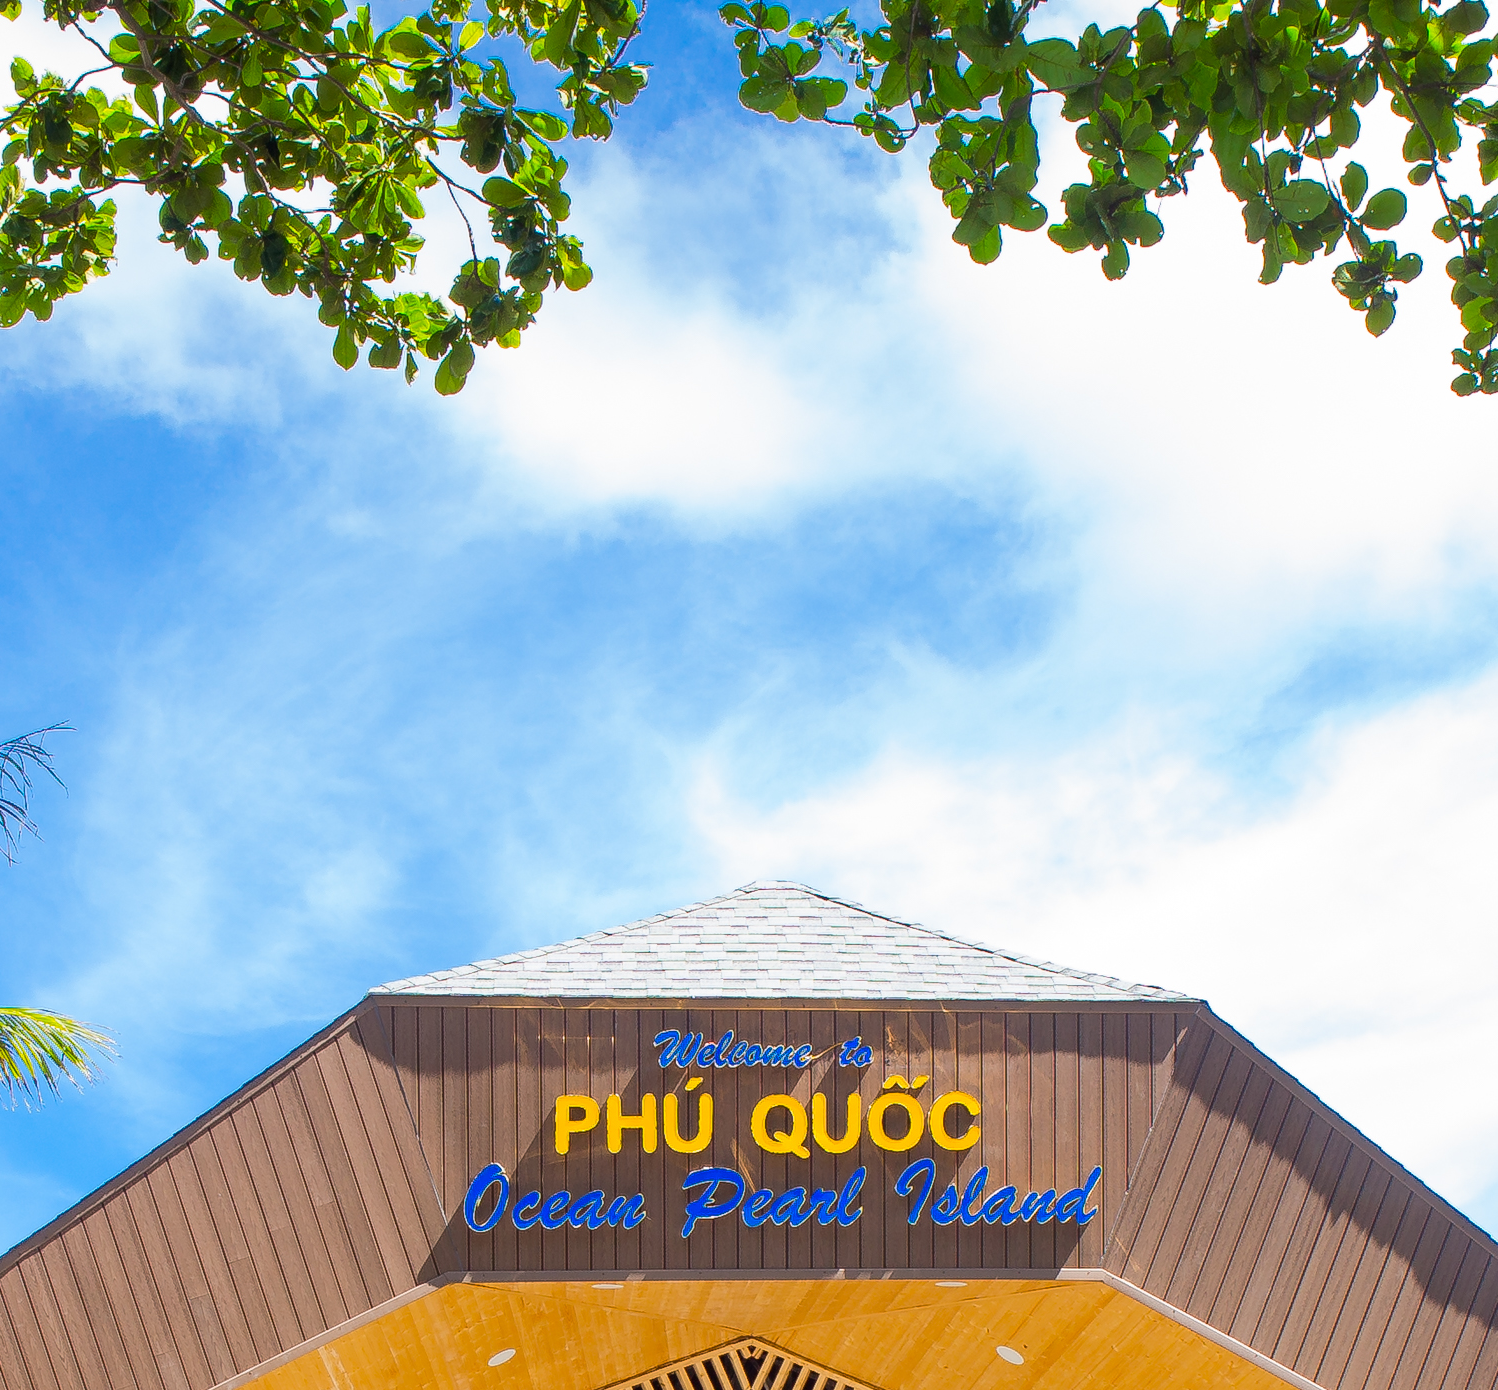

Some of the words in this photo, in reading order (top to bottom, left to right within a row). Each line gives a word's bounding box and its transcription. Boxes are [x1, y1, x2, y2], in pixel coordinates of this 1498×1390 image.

[653, 1029, 813, 1068] Welcome
[838, 1036, 873, 1067] to
[554, 1075, 714, 1155] PHÚ
[749, 1073, 982, 1160] QUỐC
[463, 1161, 646, 1233] Ocean
[680, 1166, 867, 1238] Pearl
[894, 1157, 1103, 1226] Island
